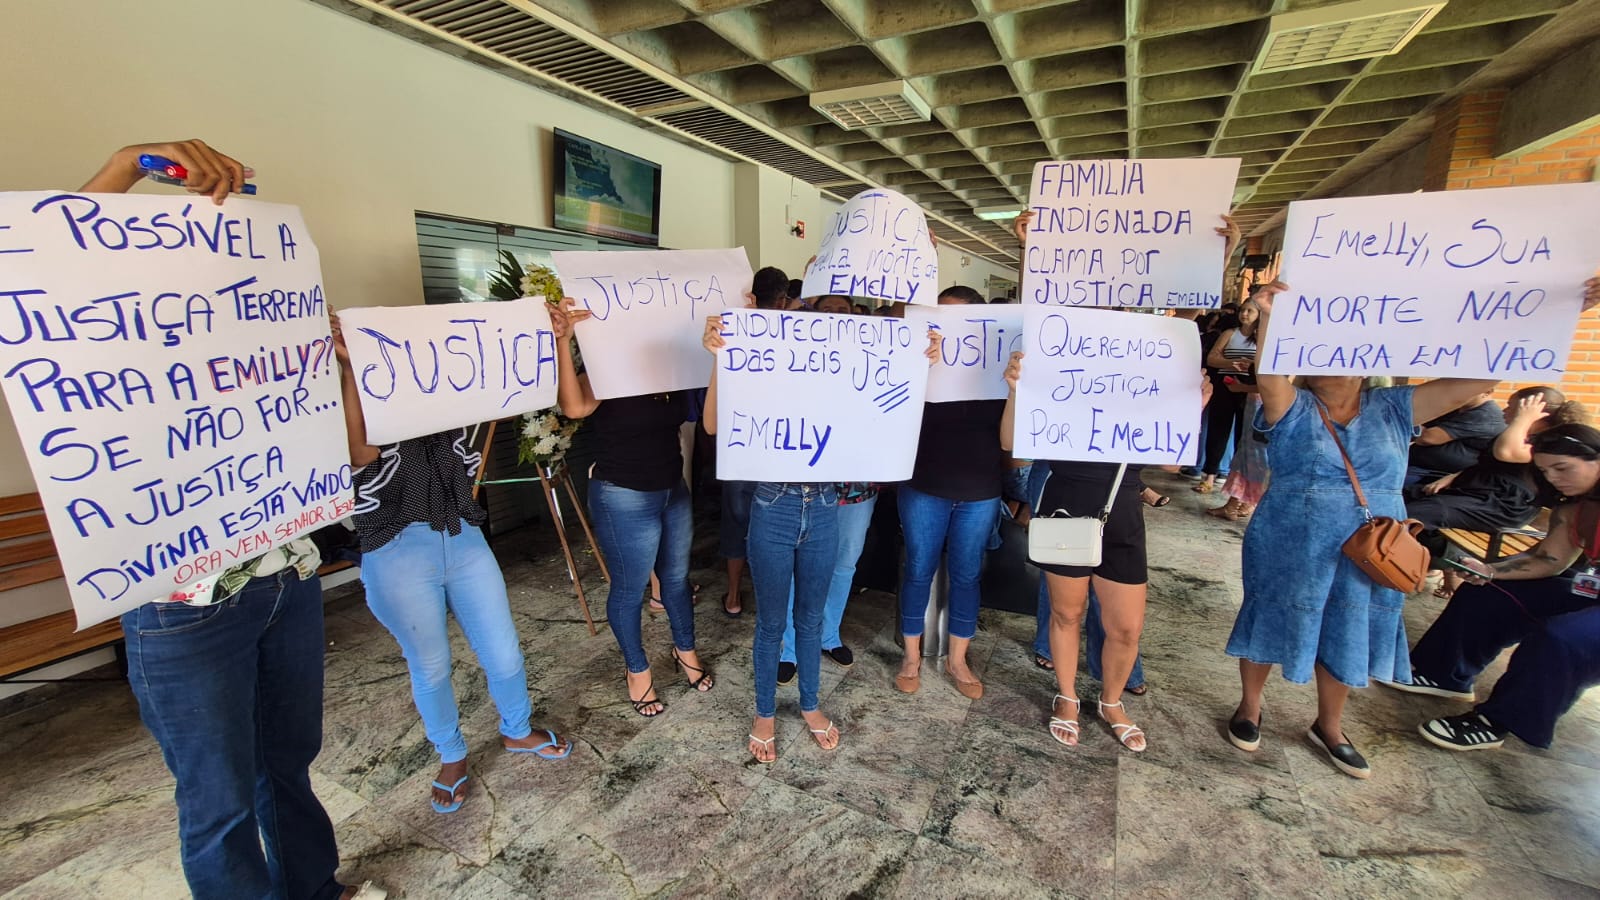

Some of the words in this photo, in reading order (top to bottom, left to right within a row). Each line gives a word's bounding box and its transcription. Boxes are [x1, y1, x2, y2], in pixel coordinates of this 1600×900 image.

[32, 194, 266, 259] POSSÍVEL
[278, 222, 297, 261] A
[1028, 246, 1103, 275] CLAMA
[0, 289, 215, 347] JUSTIÇA
[216, 276, 323, 322] TERRENA
[575, 270, 726, 320] JUSTIÇA
[1035, 276, 1154, 307] JUSTIÇA
[1293, 294, 1424, 326] MORTE
[1457, 281, 1546, 323] NÃO
[4, 357, 155, 412] PARA
[166, 362, 198, 401] A
[357, 319, 556, 408] JUSTIÇA
[1272, 337, 1393, 371] FICARA
[1409, 343, 1463, 367] EM
[40, 427, 142, 481] SE
[167, 405, 244, 458] NÃO
[65, 497, 114, 537] A
[126, 446, 283, 525] JUSTIÇA
[77, 525, 209, 600] DIVINA
[219, 481, 291, 538] ESTÁ
[291, 464, 352, 506] VINDO
[173, 553, 222, 584] ORA
[274, 506, 325, 540] SENHOR
